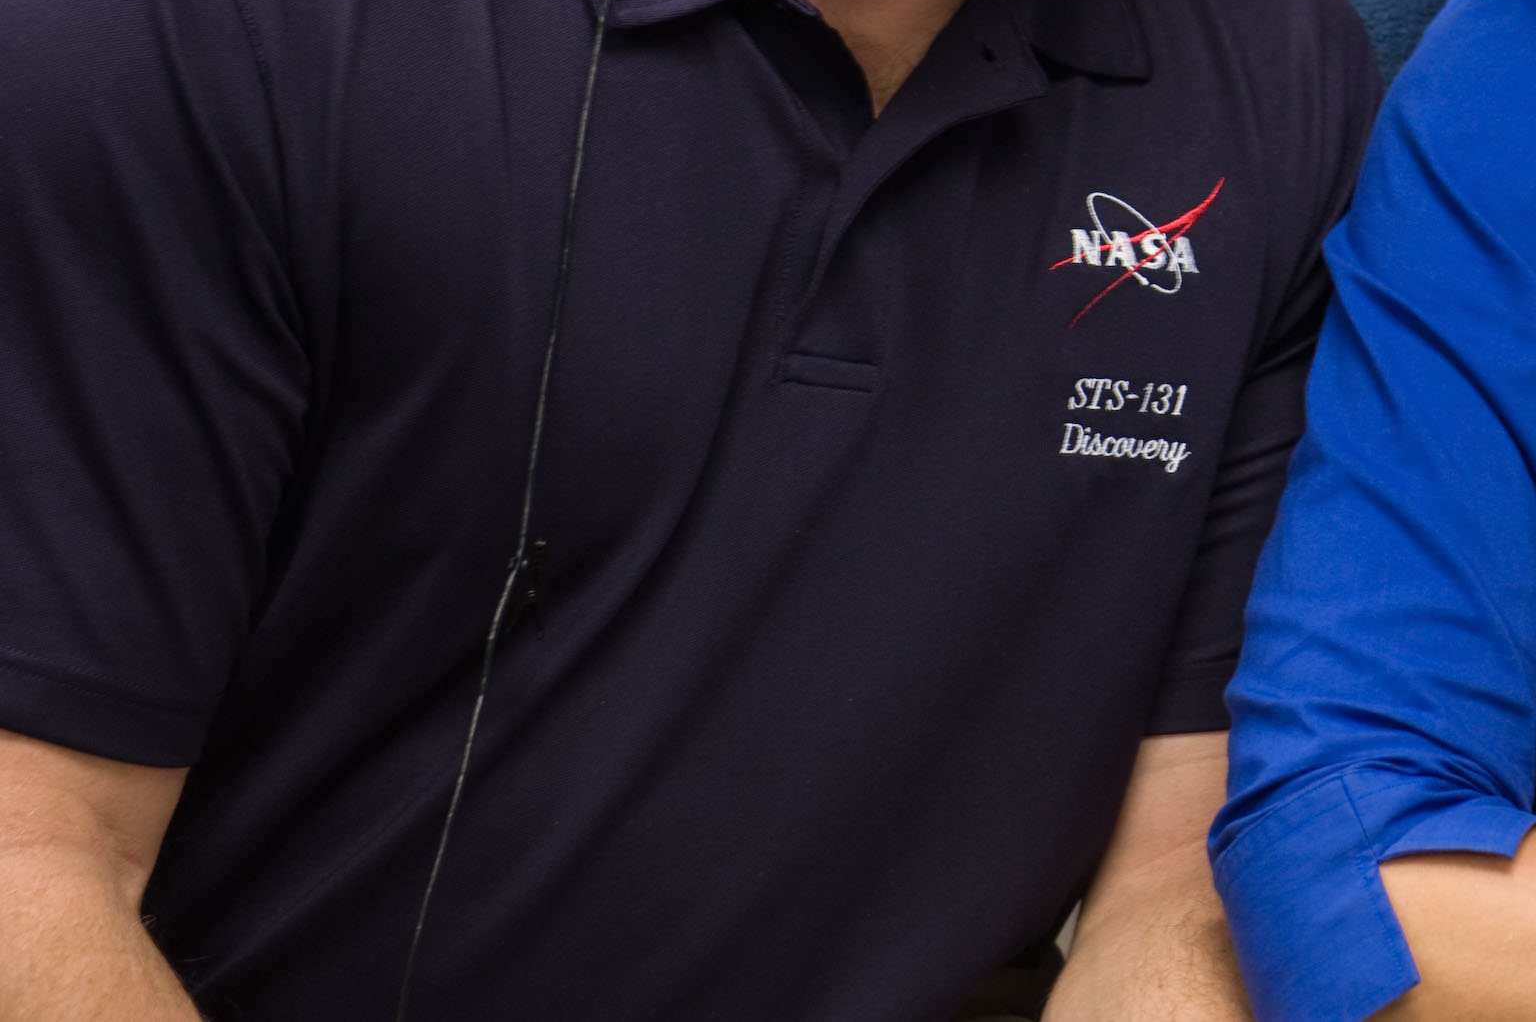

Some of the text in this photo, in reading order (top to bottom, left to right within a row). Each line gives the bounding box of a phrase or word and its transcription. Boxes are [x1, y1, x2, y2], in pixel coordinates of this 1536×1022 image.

[1069, 228, 1200, 274] NASA
[1067, 378, 1188, 415] STS-131
[1060, 423, 1191, 473] Discovery
